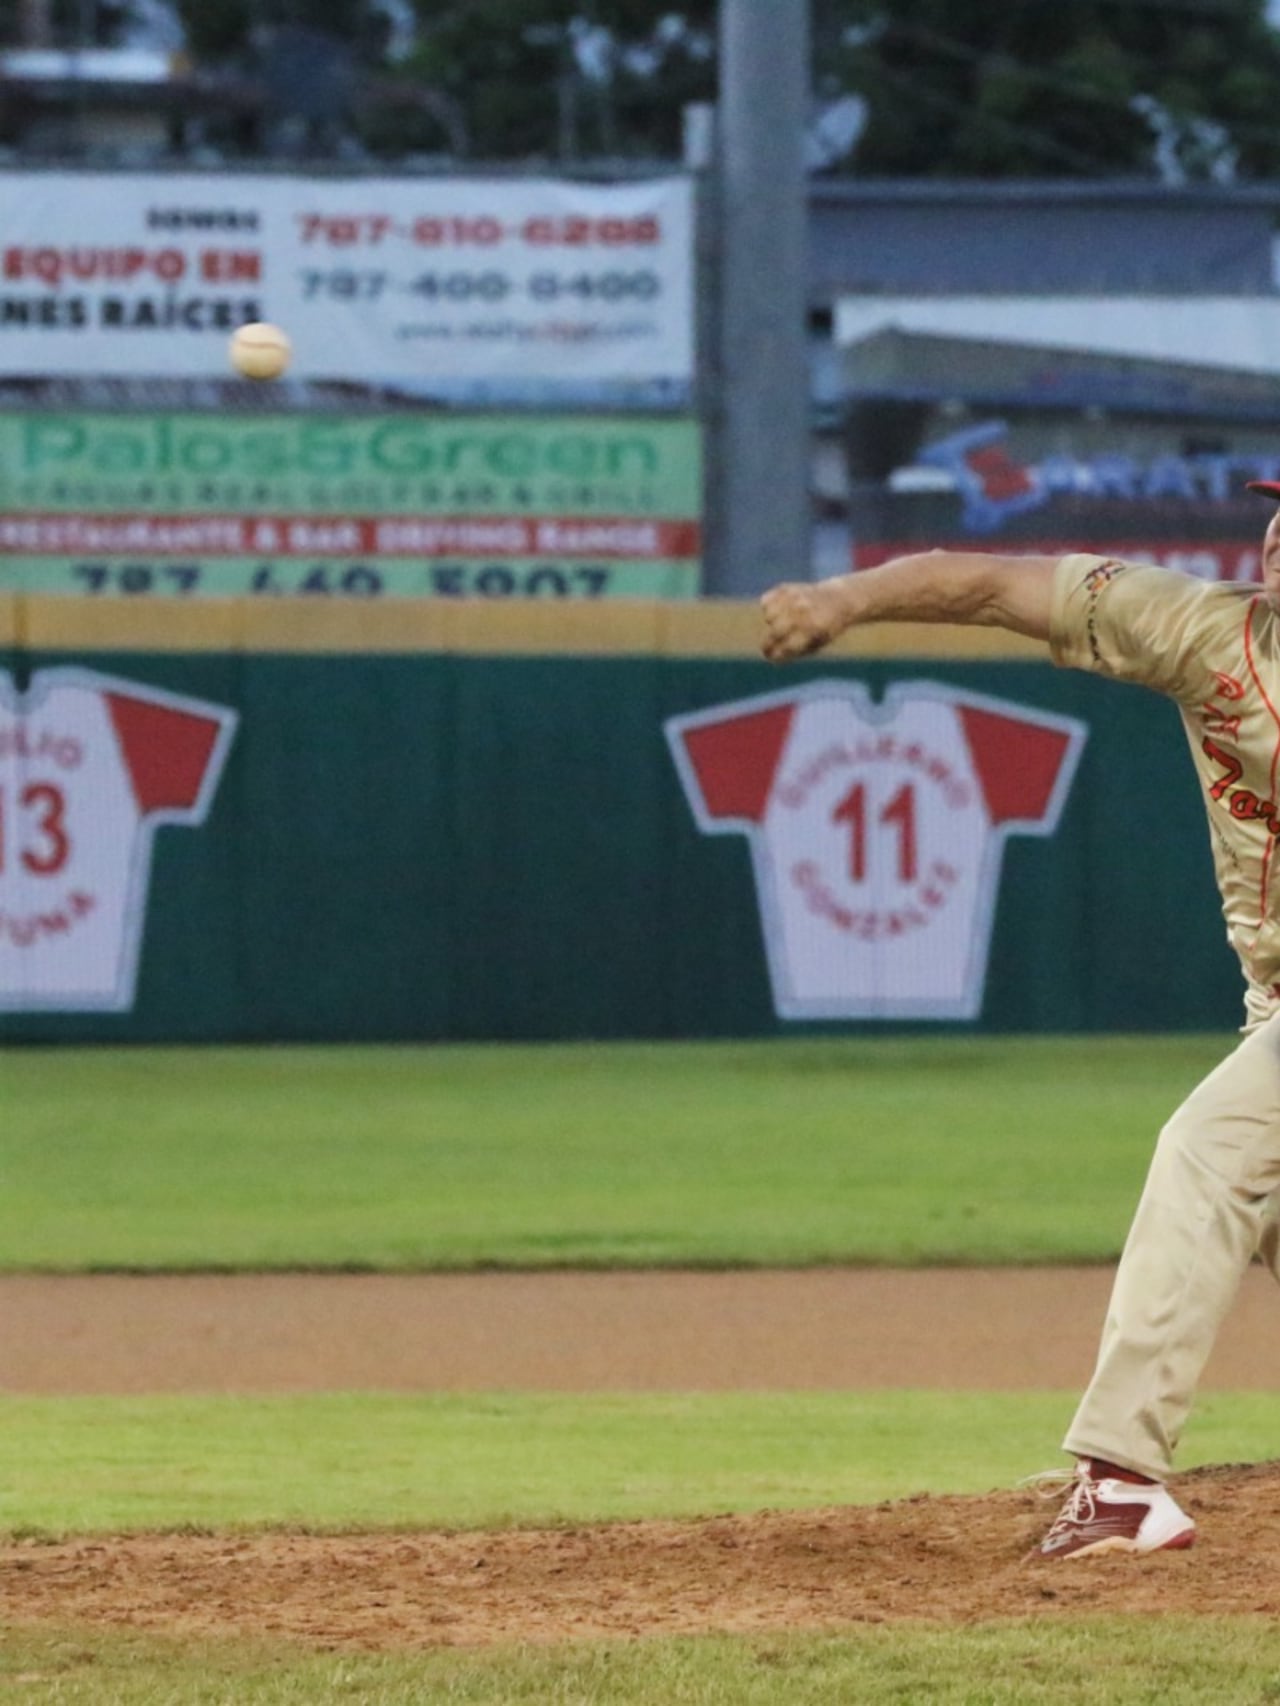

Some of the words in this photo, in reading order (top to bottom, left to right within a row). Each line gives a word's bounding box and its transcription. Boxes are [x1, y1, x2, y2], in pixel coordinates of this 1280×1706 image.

[3, 249, 187, 291] EQUIPO
[202, 250, 261, 282] EN
[832, 780, 918, 885] 11
